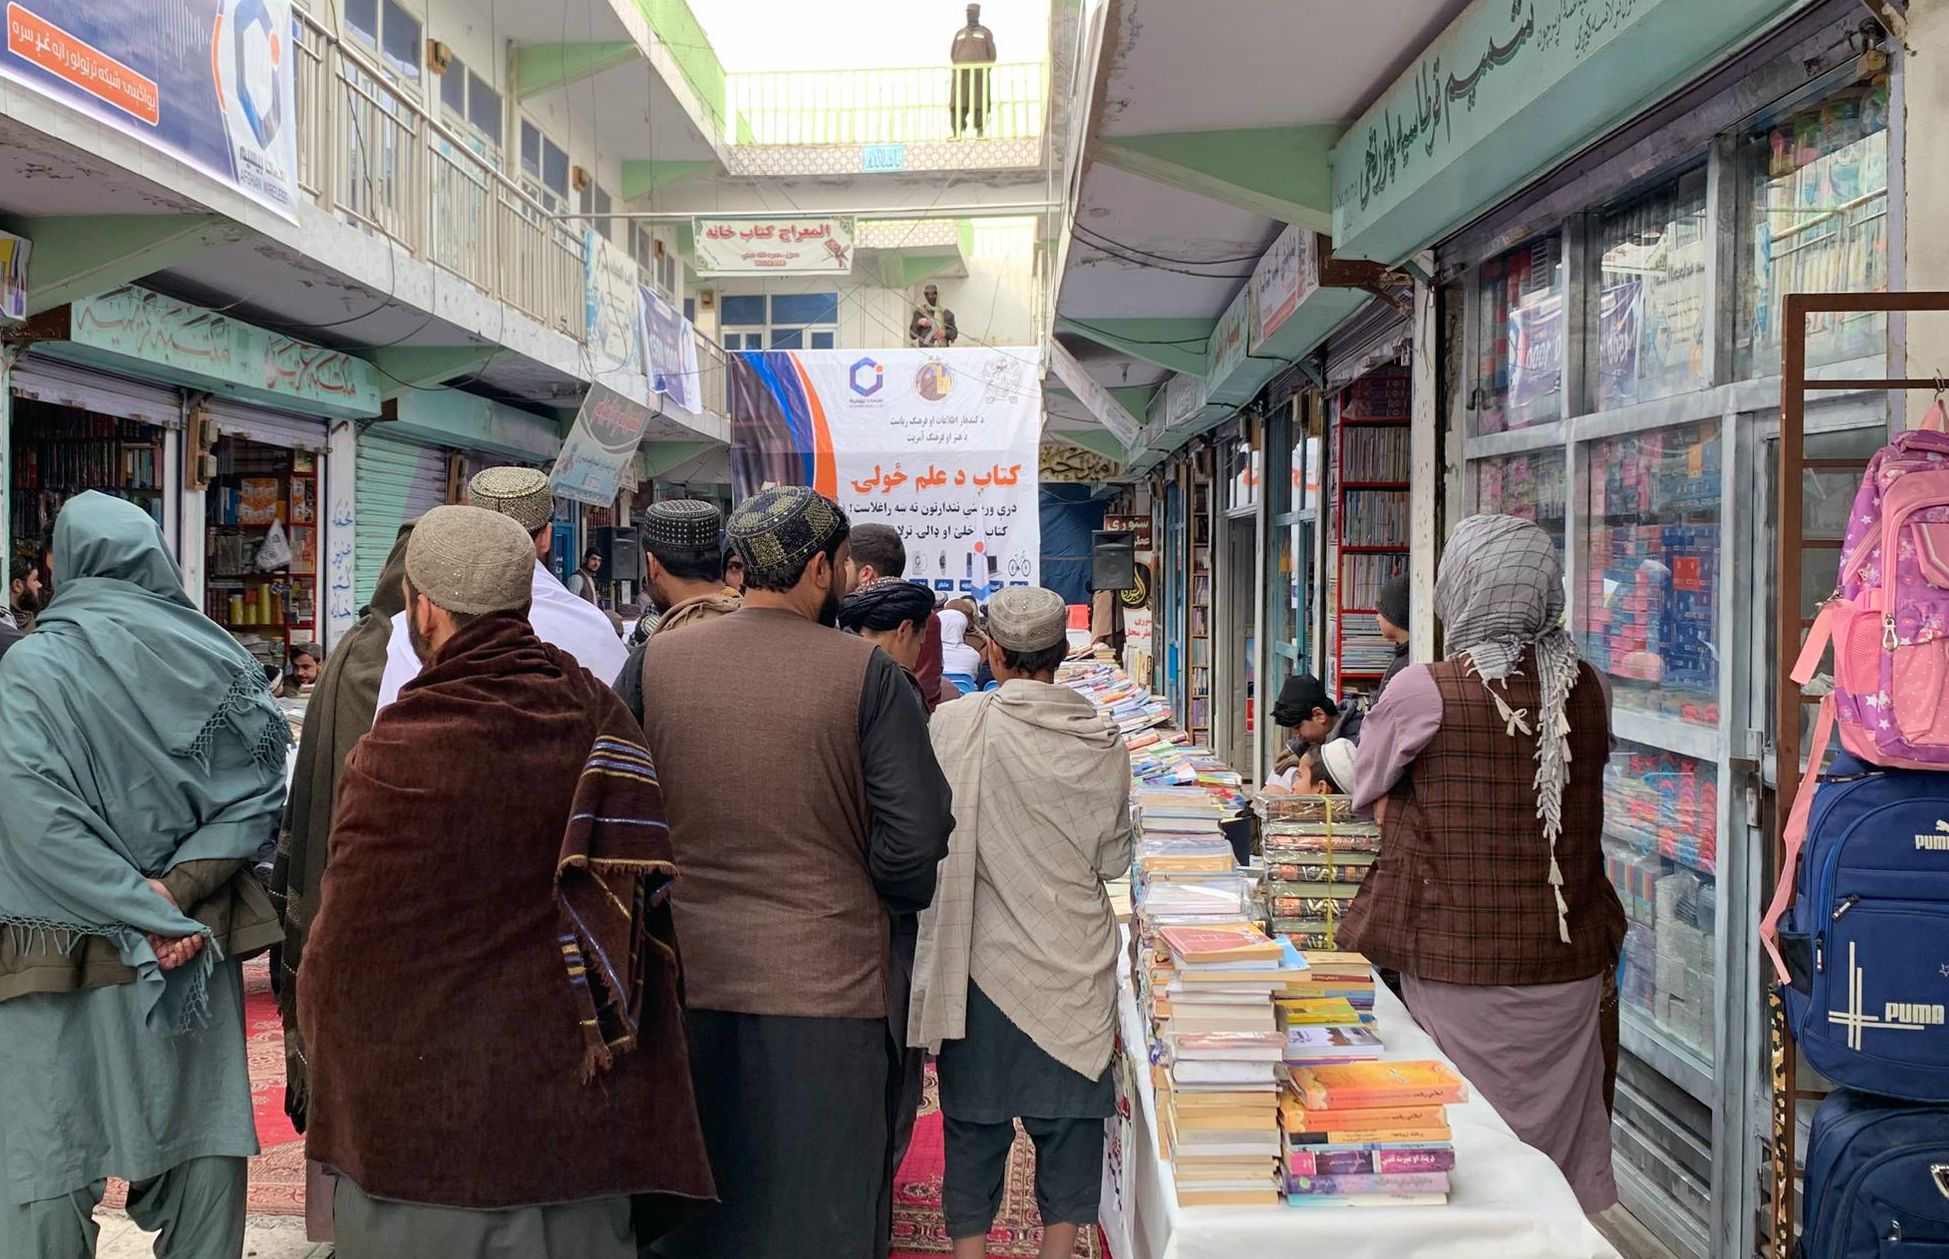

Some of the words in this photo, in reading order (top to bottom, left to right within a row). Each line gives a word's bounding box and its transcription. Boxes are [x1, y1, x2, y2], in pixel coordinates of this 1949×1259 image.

[12, 20, 33, 42] سره
[705, 224, 736, 240] خانه
[739, 224, 775, 242] کتاب
[779, 224, 831, 242] المعراج
[915, 464, 948, 493] علم
[954, 466, 966, 486] د
[972, 464, 1022, 491] کتاب
[1885, 1002, 1945, 1024] PUMA
